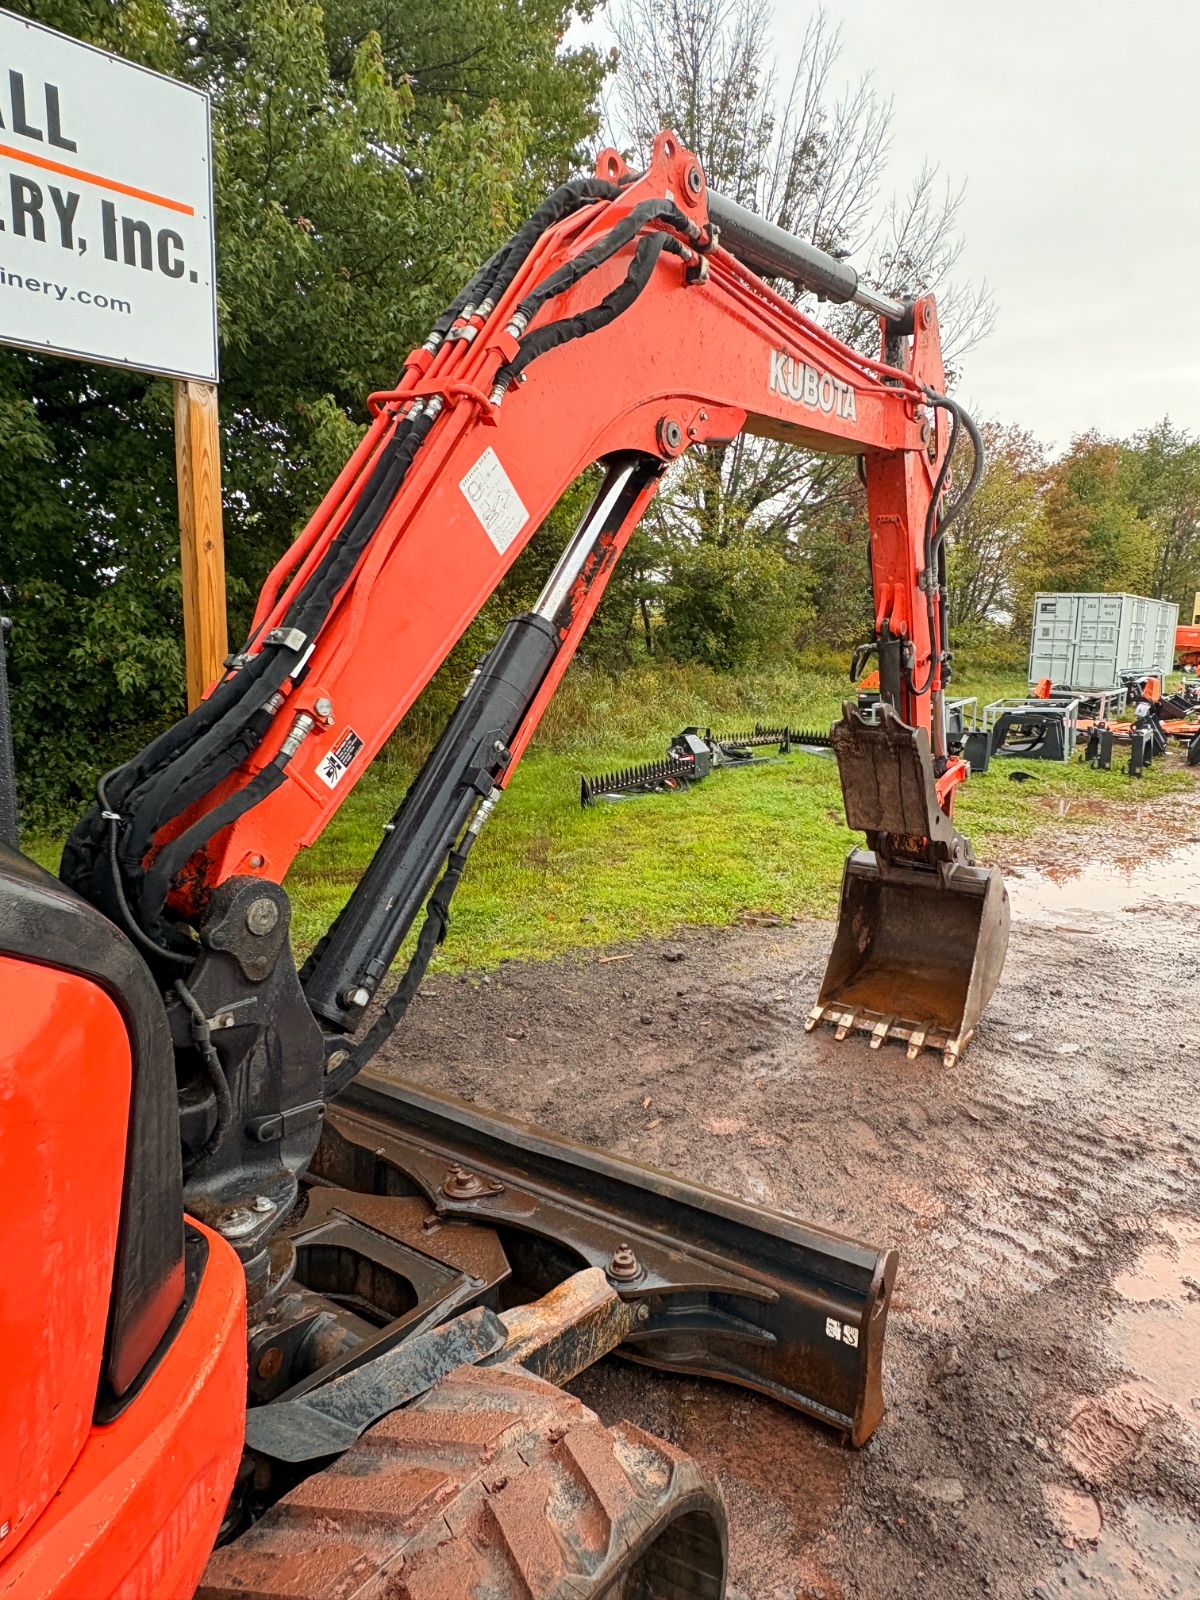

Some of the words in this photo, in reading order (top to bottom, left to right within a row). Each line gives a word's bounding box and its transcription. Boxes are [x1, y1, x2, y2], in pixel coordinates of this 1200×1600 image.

[0, 69, 78, 154] LL
[0, 172, 87, 257] RY,
[101, 199, 198, 284] Inc.
[0, 266, 131, 314] inery.com
[769, 348, 857, 424] KUBOTA
